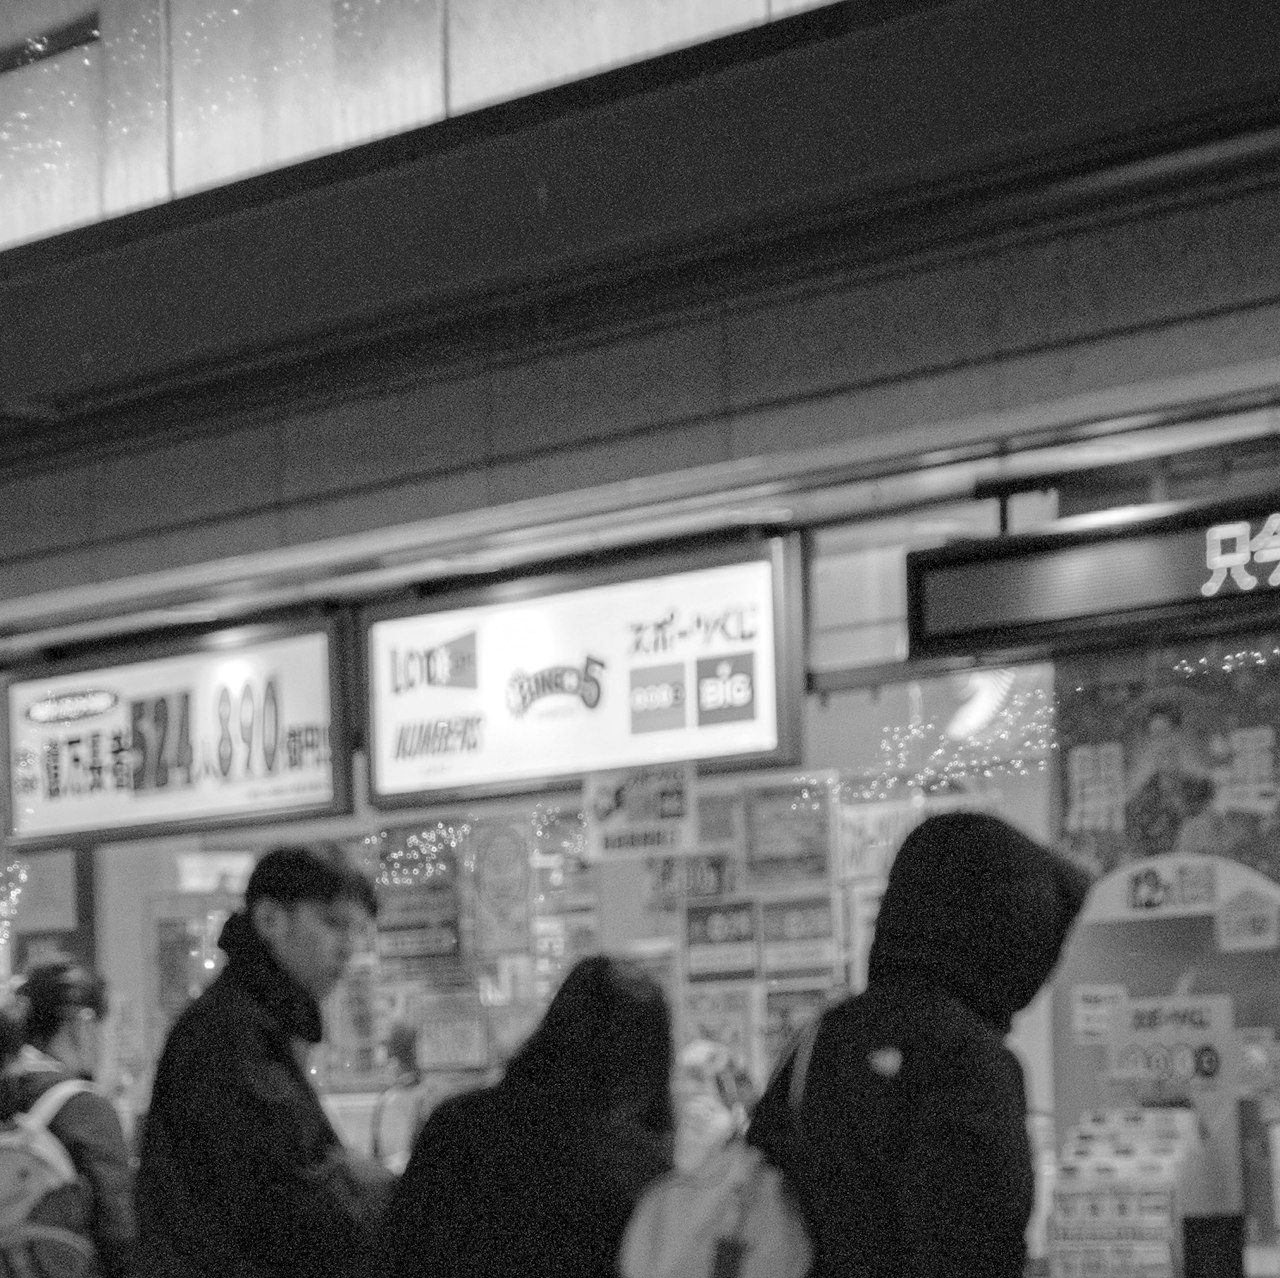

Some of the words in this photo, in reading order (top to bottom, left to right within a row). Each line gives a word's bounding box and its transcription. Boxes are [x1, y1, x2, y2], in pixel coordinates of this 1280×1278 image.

[627, 602, 756, 655] スポーツくじ
